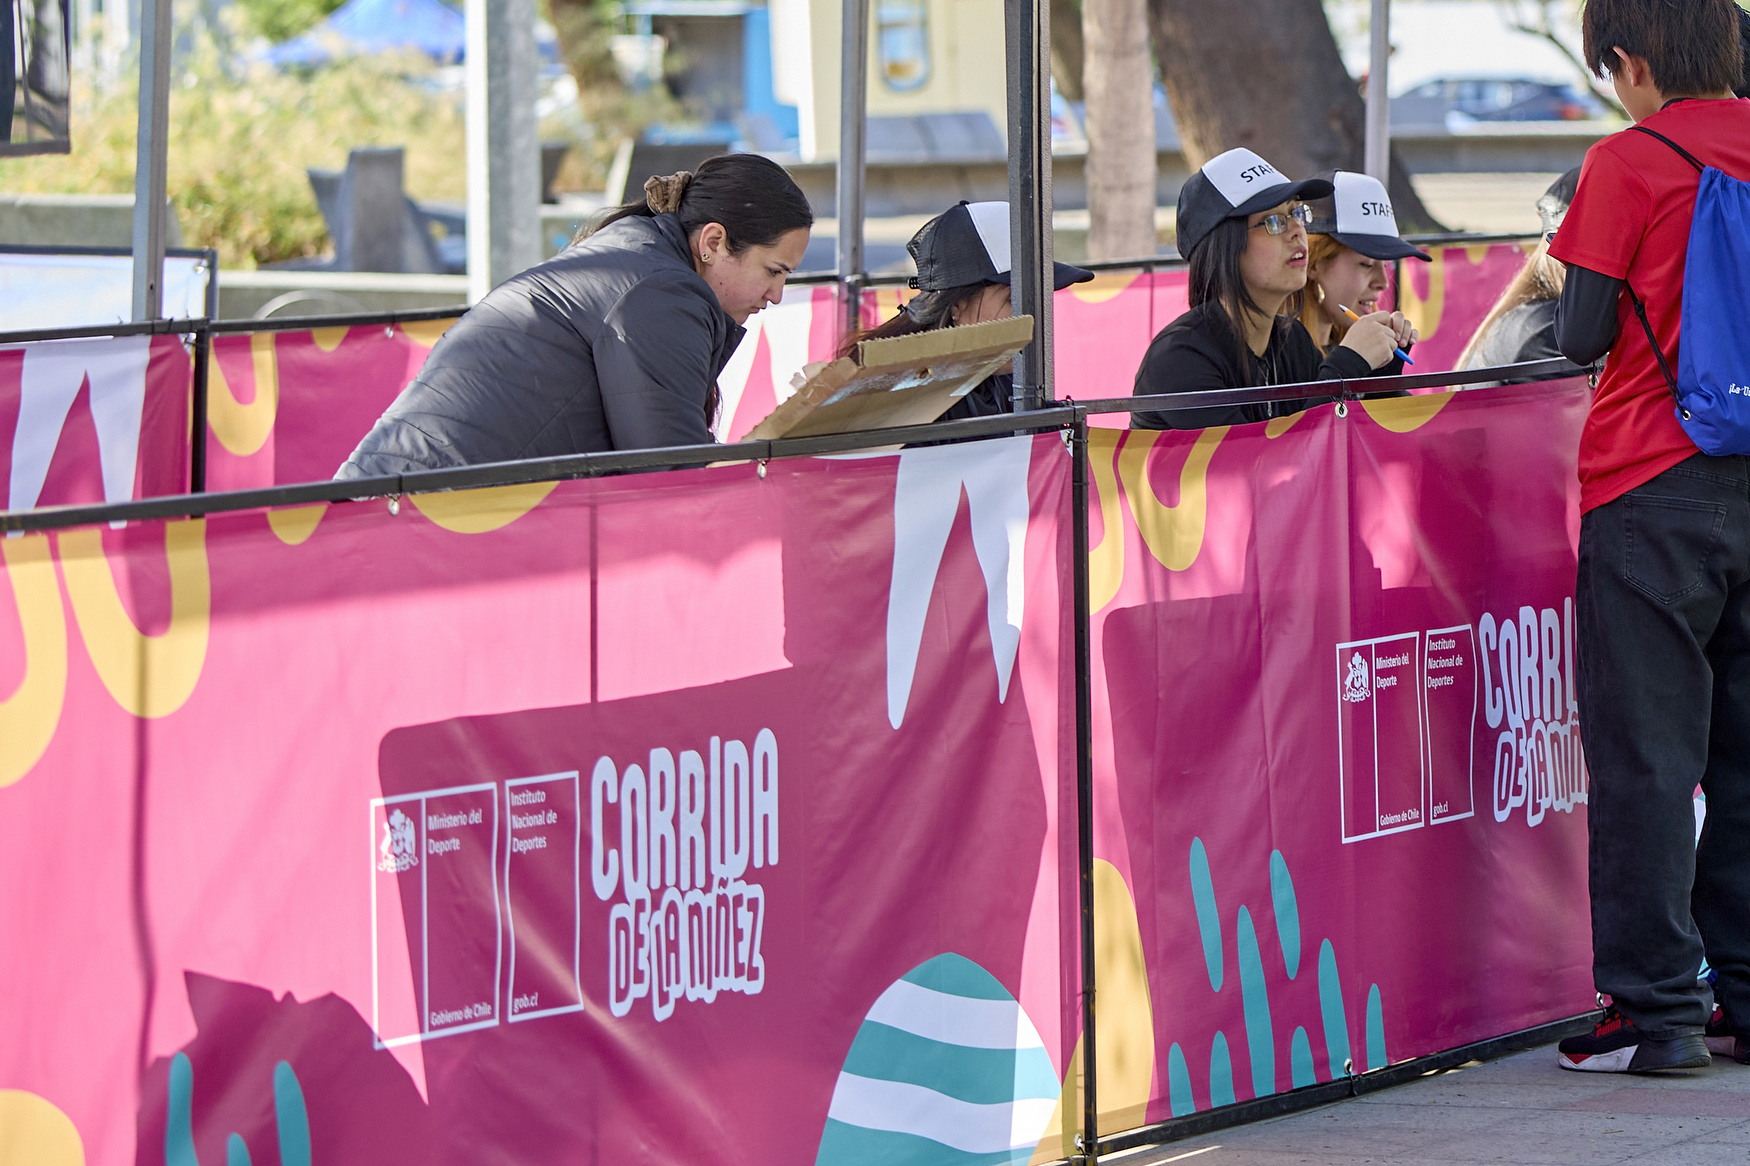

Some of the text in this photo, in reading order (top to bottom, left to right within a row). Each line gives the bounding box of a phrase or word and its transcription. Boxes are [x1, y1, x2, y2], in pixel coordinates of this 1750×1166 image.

[1429, 638, 1456, 651] Instituto
[1376, 652, 1410, 670] Ministerio del
[1428, 654, 1463, 670] Nacional de
[1479, 597, 1578, 728] CORRI
[1376, 675, 1398, 690] Deporte
[1427, 675, 1454, 690] Deportes
[1548, 709, 1588, 813] NIÑ
[510, 790, 547, 807] Instituto
[591, 728, 778, 902] CORRIDA
[1380, 808, 1420, 827] Gobierno de Chile
[1433, 801, 1449, 817] gob.cl
[427, 808, 483, 831] Ministerio del
[511, 808, 558, 830] Nacional de
[427, 836, 461, 854] Deporte
[511, 834, 548, 854] Deportes
[609, 876, 765, 1022] DE LA NIÑEZ
[513, 992, 539, 1013] gob.cl
[430, 1001, 492, 1027] Gobierno de Chile
